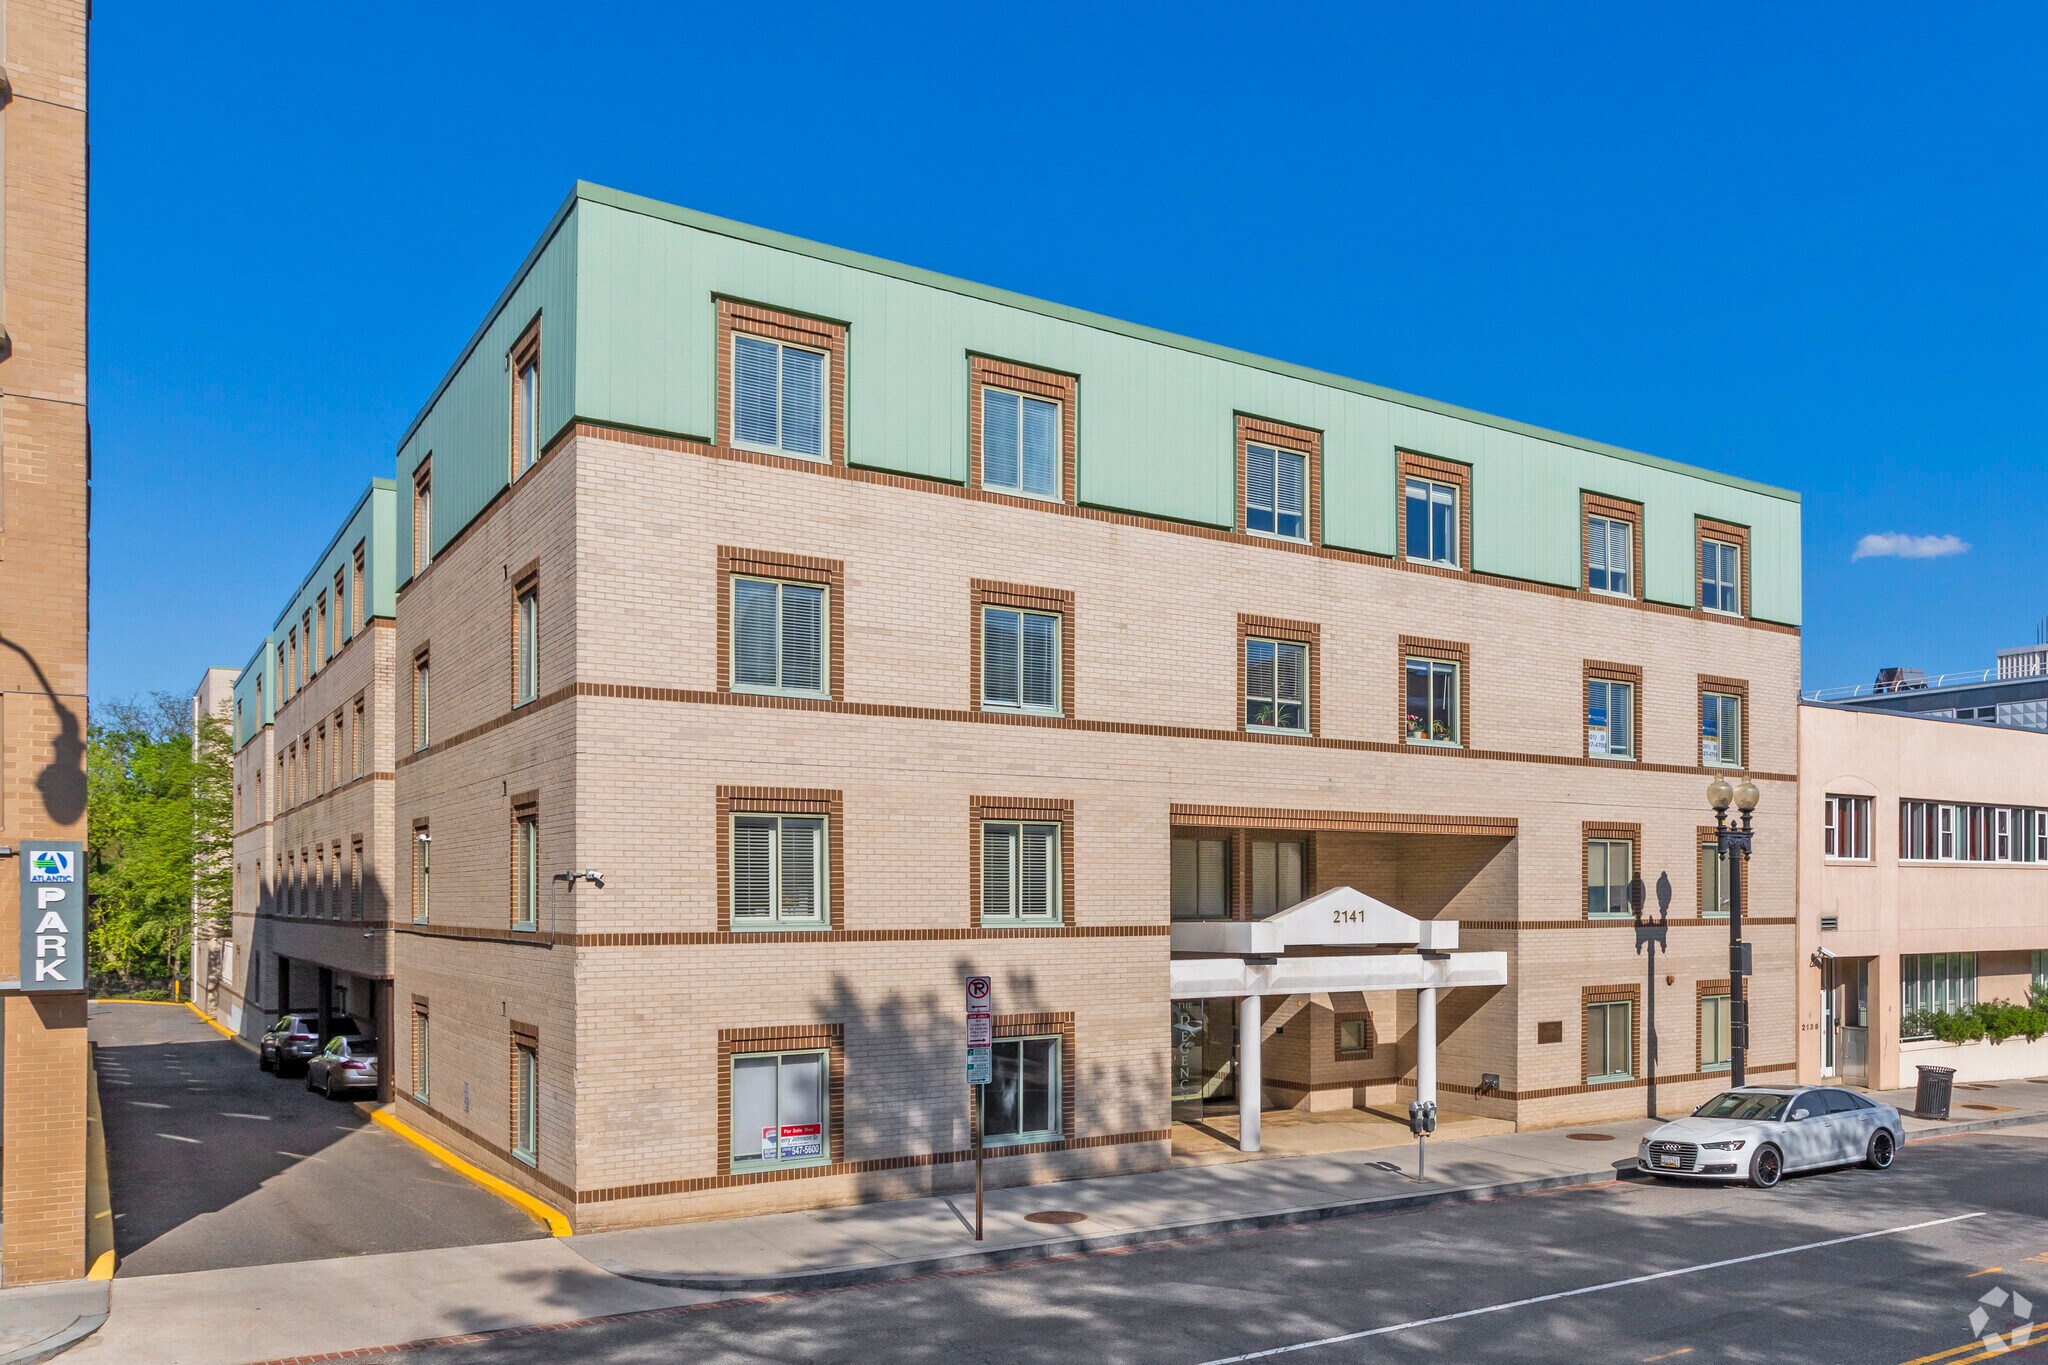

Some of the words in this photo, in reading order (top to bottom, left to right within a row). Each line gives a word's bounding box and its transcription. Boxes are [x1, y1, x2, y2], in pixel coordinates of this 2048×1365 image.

[35, 887, 69, 982] PARK
[1333, 910, 1365, 923] 2141
[1801, 1023, 1819, 1031] 2139
[1180, 1015, 1196, 1103] REGENCY
